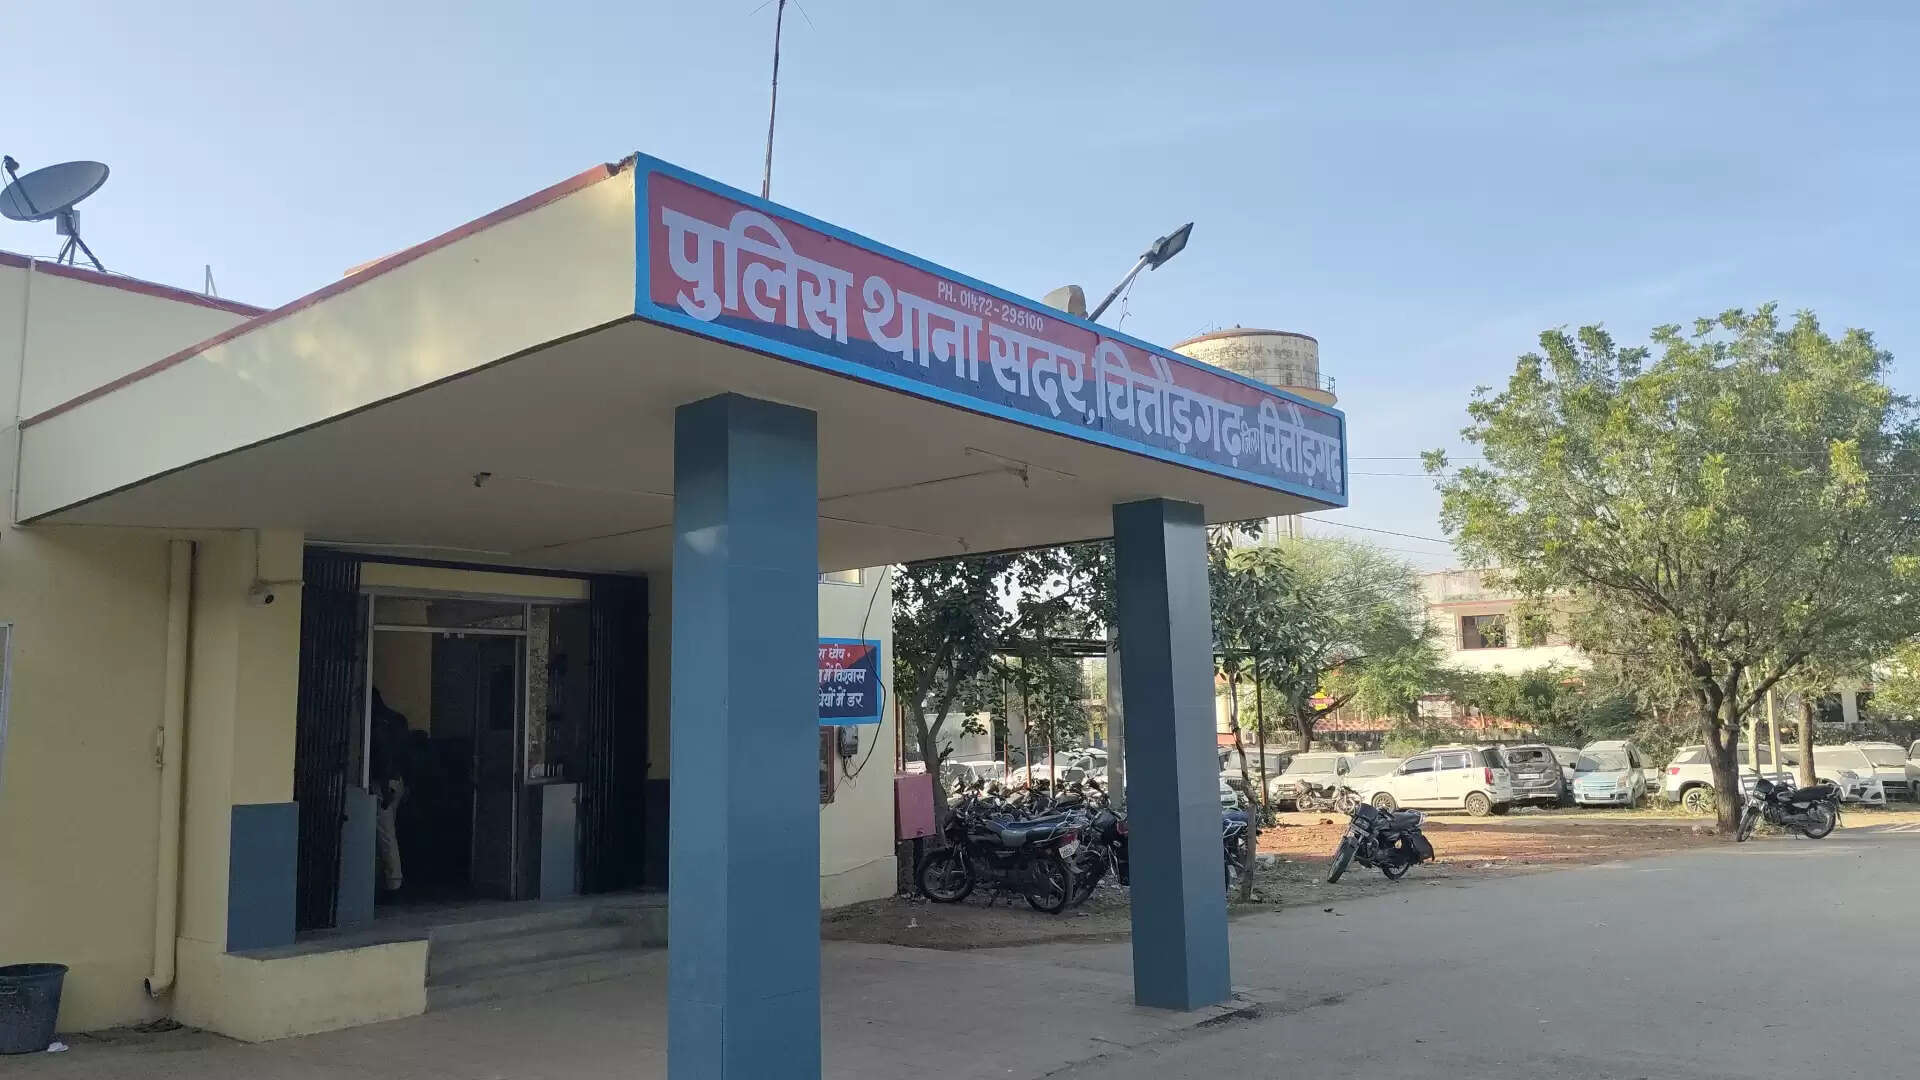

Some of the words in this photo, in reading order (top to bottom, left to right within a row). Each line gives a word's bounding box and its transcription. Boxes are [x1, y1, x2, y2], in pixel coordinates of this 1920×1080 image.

[661, 206, 853, 345] पुलिस
[863, 275, 982, 382] थाना
[938, 281, 957, 303] PH.
[960, 290, 1044, 332] 01472-295100
[847, 692, 864, 708] डर
